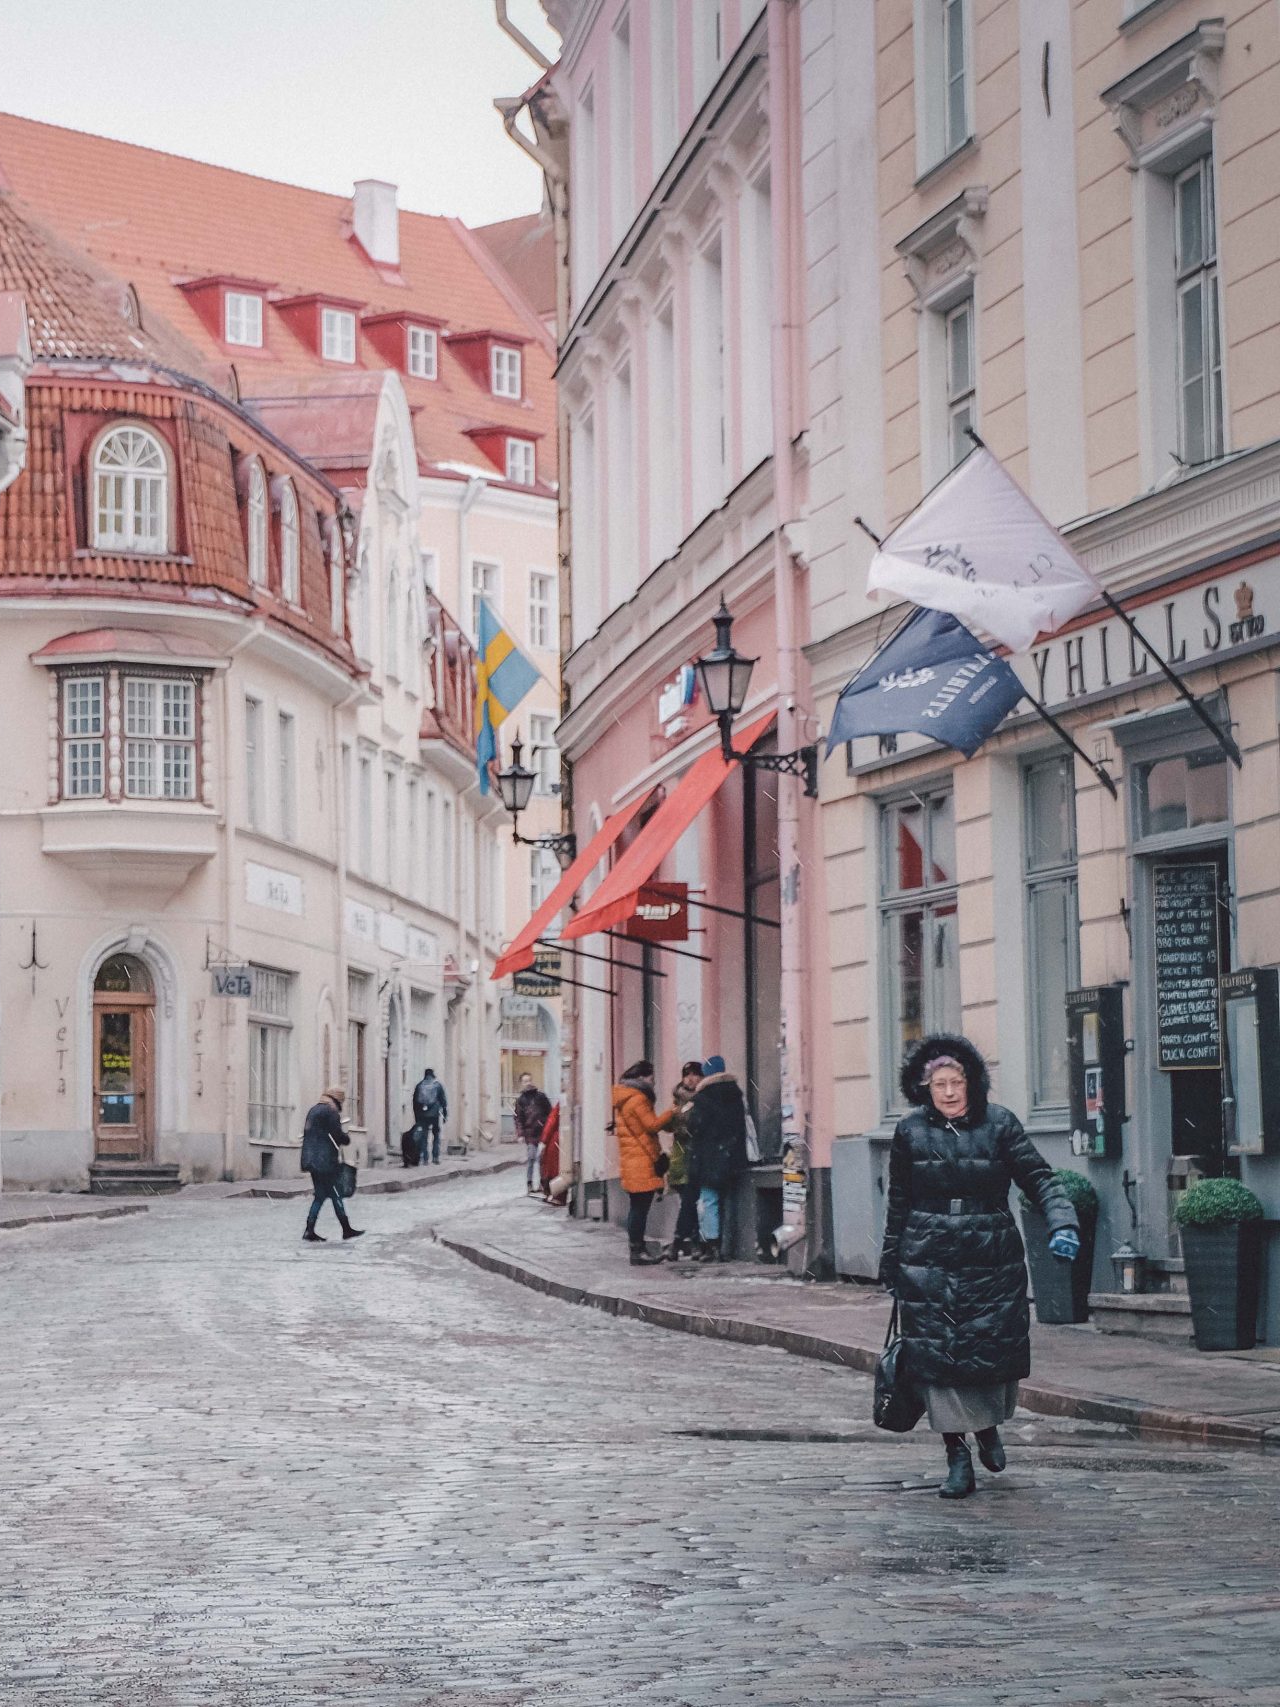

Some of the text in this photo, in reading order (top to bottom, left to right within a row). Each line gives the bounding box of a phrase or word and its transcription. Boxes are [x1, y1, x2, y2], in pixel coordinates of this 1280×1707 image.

[1007, 586, 1221, 714] YHILLS
[216, 975, 251, 995] VeTa
[1188, 1000, 1216, 1013] BURGER
[1183, 1032, 1209, 1044] CONFIT
[1162, 1046, 1217, 1060] DUCK CONFIT
